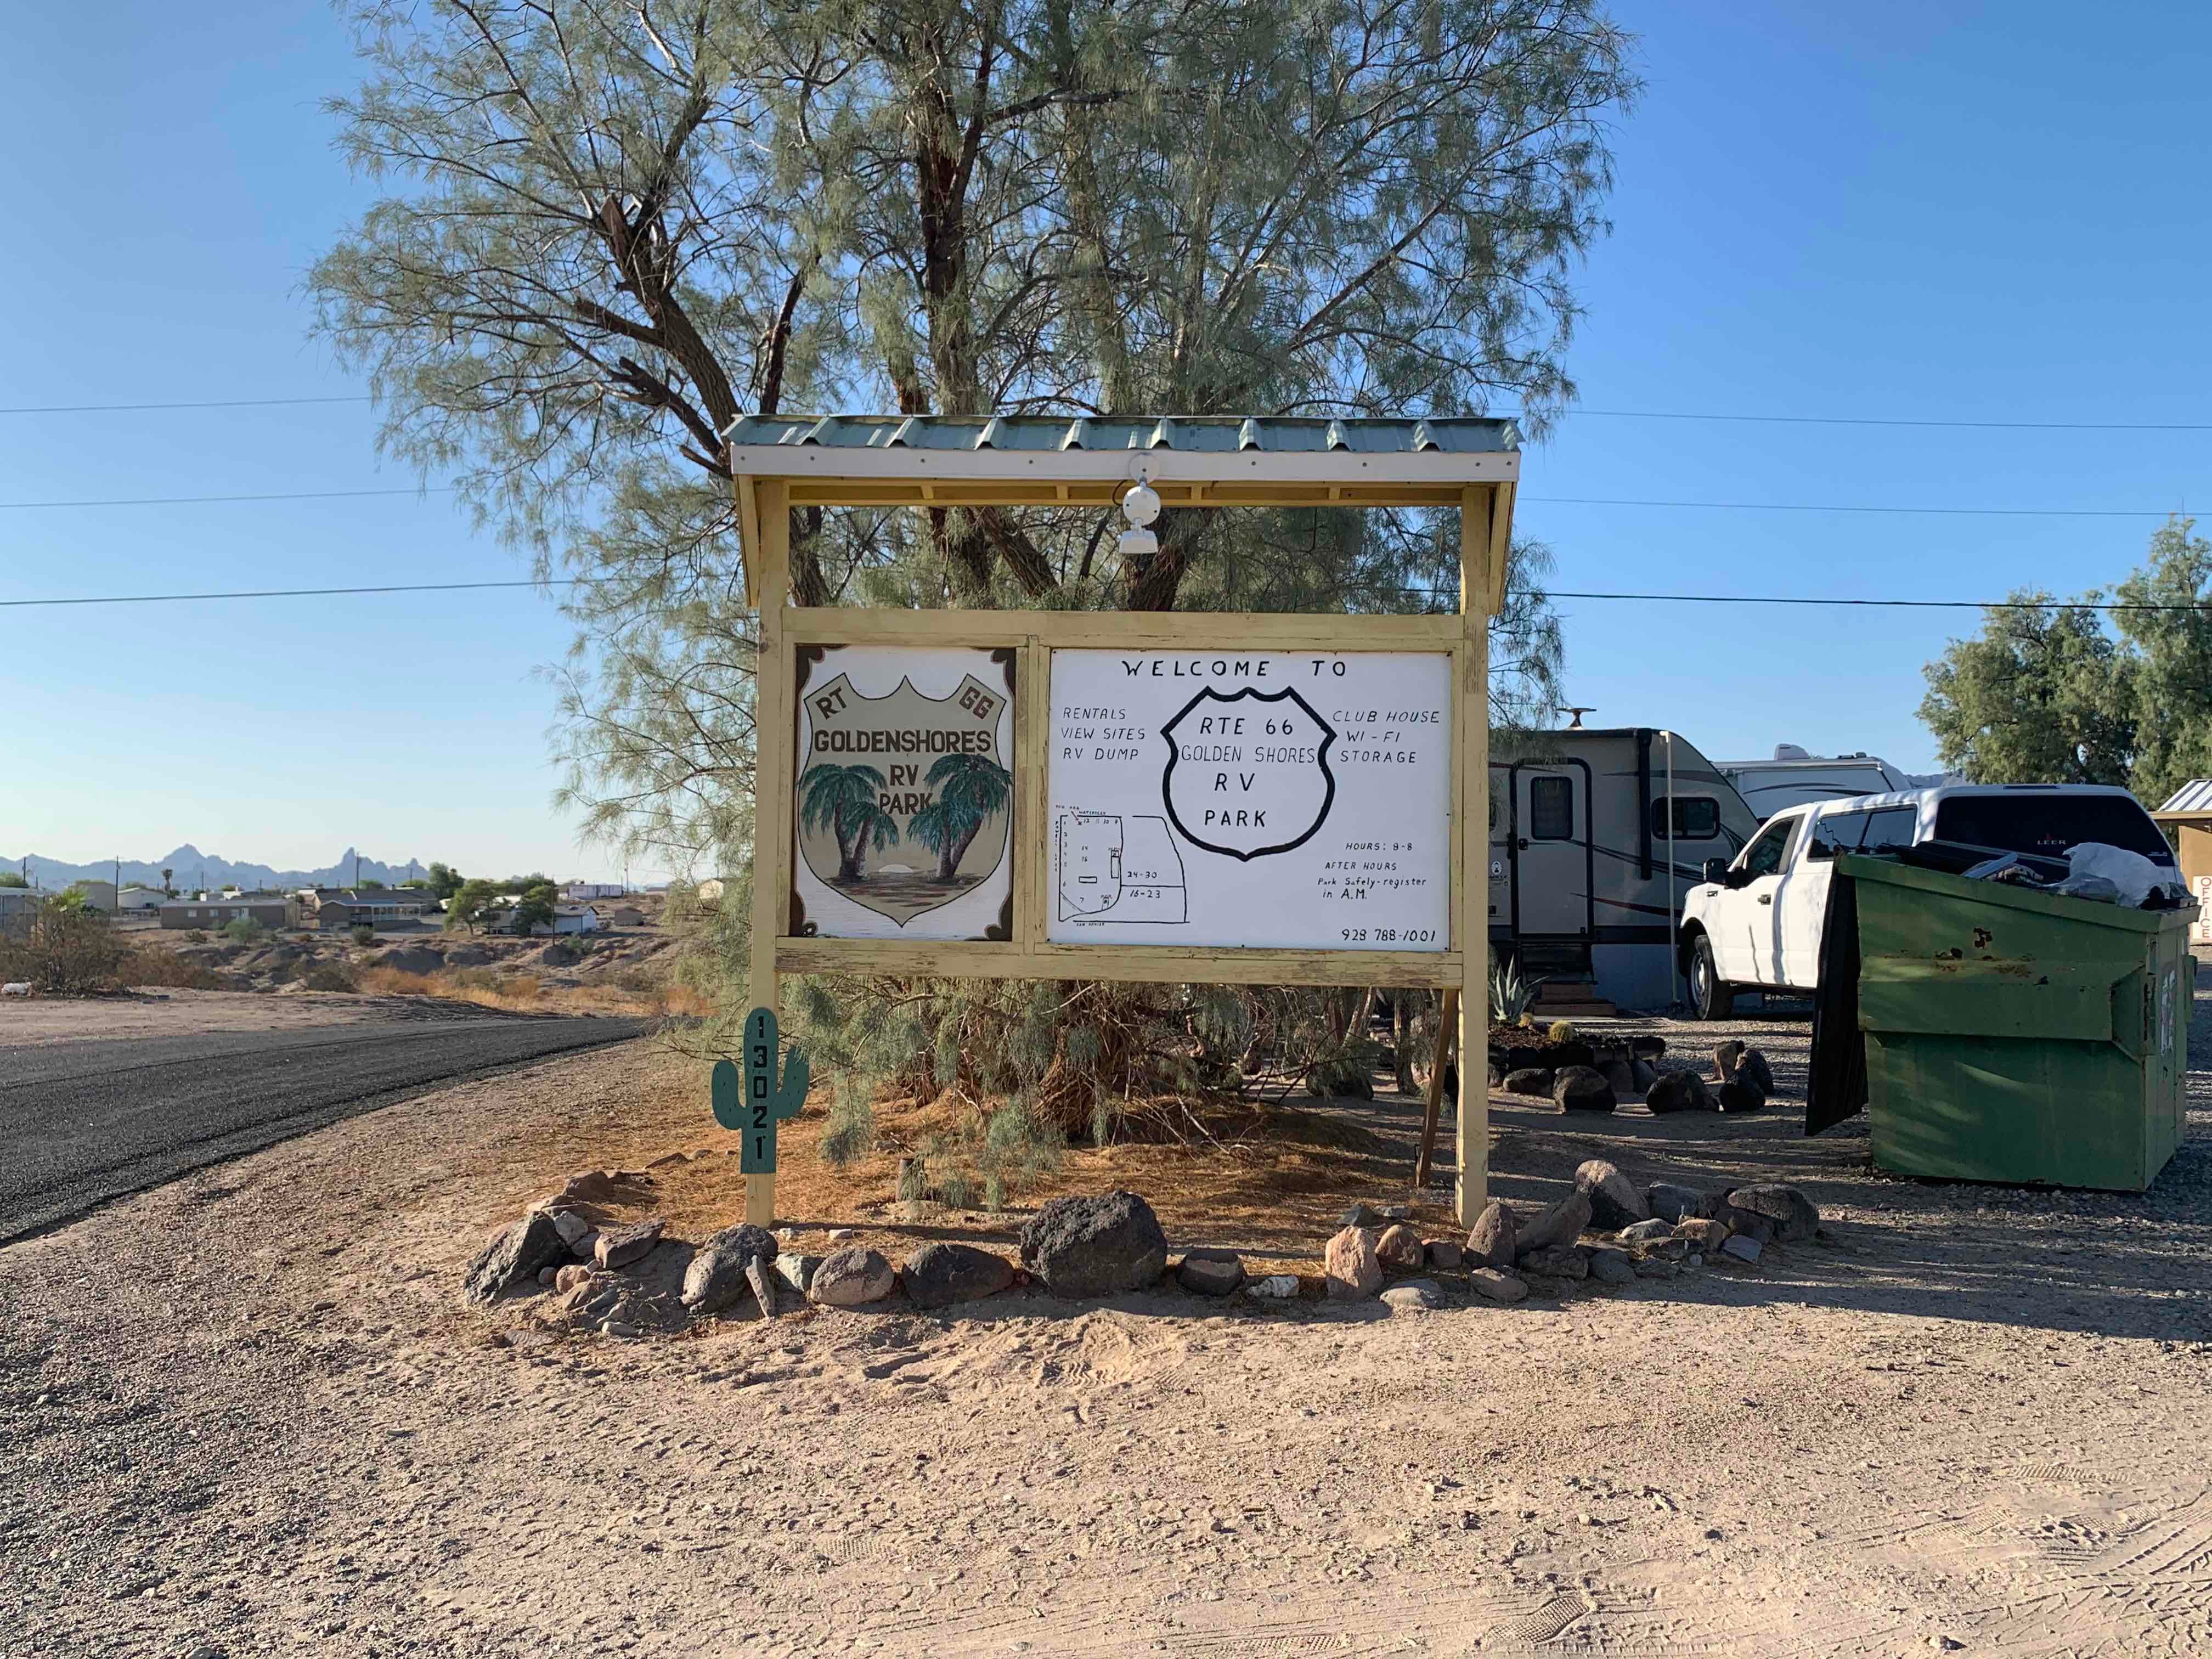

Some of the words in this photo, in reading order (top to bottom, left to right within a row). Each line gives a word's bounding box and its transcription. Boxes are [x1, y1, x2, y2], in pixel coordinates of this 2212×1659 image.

[1121, 660, 1269, 676] WELCOME
[1312, 660, 1346, 676] TO
[815, 686, 847, 720] RT
[1063, 707, 1126, 720] RENTALS
[1333, 710, 1378, 723] CLUB
[1386, 711, 1440, 724] HOUSE
[1060, 727, 1094, 740] VIEW
[1103, 728, 1146, 740] SITES
[1200, 716, 1245, 735] RTE
[1266, 718, 1293, 735] 66
[814, 729, 991, 753] GOLDENSHORES
[1063, 748, 1084, 760] RV
[1094, 748, 1139, 761] DUMP
[1181, 745, 1242, 761] GOLDEN
[1255, 747, 1315, 763] SHORES
[1340, 751, 1417, 763] STORAGE
[889, 764, 918, 786] RV
[1214, 772, 1255, 792] RV
[879, 793, 933, 815] PARK
[1204, 809, 1267, 827] PARK
[1345, 842, 1387, 851] HOURS:
[1325, 861, 1357, 870] AFTER
[1363, 862, 1397, 871] HOURS
[1317, 877, 1336, 885] Park
[1323, 889, 1333, 898] in
[1341, 888, 1368, 900] A.M.
[2200, 877, 2211, 938] OFFICE
[1342, 929, 1367, 941] 928
[753, 1015, 768, 1159] 13021
